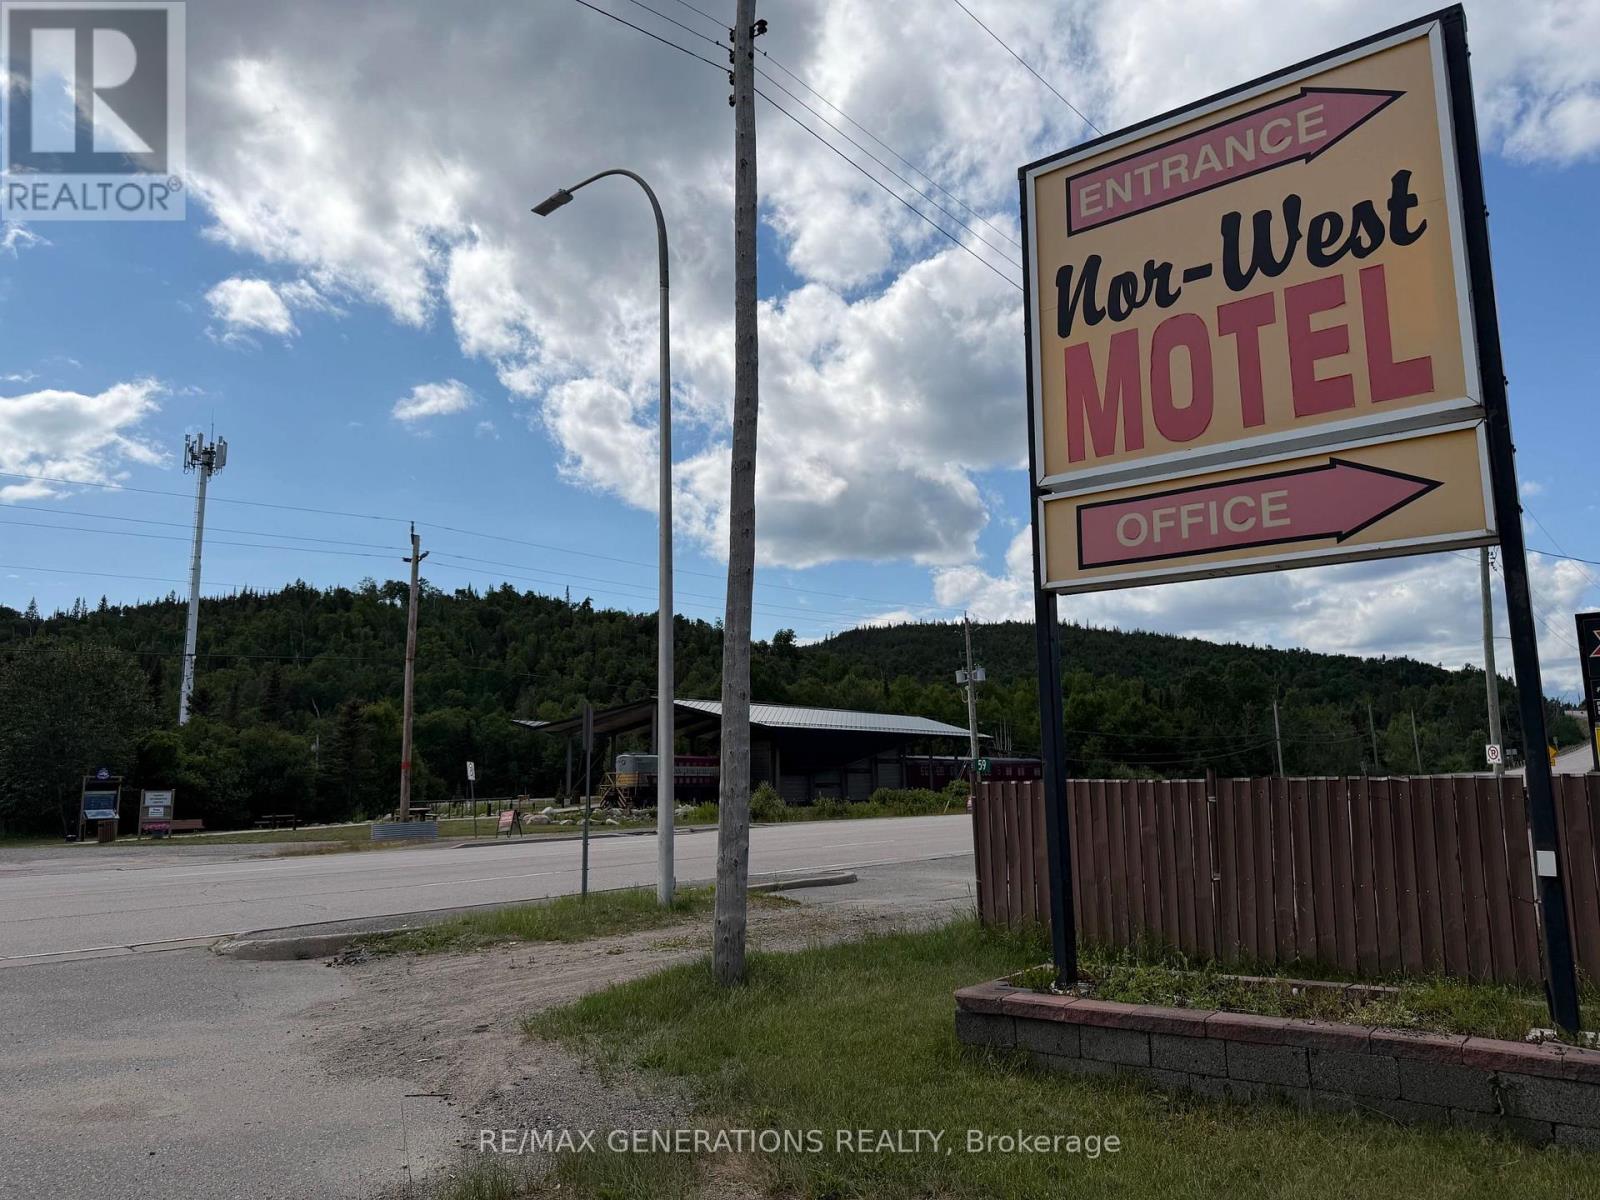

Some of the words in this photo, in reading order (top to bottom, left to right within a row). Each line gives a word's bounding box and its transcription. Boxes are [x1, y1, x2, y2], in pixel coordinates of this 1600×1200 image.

[1078, 104, 1327, 219] ENTRANCE
[1056, 170, 1427, 338] Nor-West
[1064, 264, 1435, 463] MOTEL
[1116, 490, 1291, 548] OFFICE
[977, 759, 987, 771] 59
